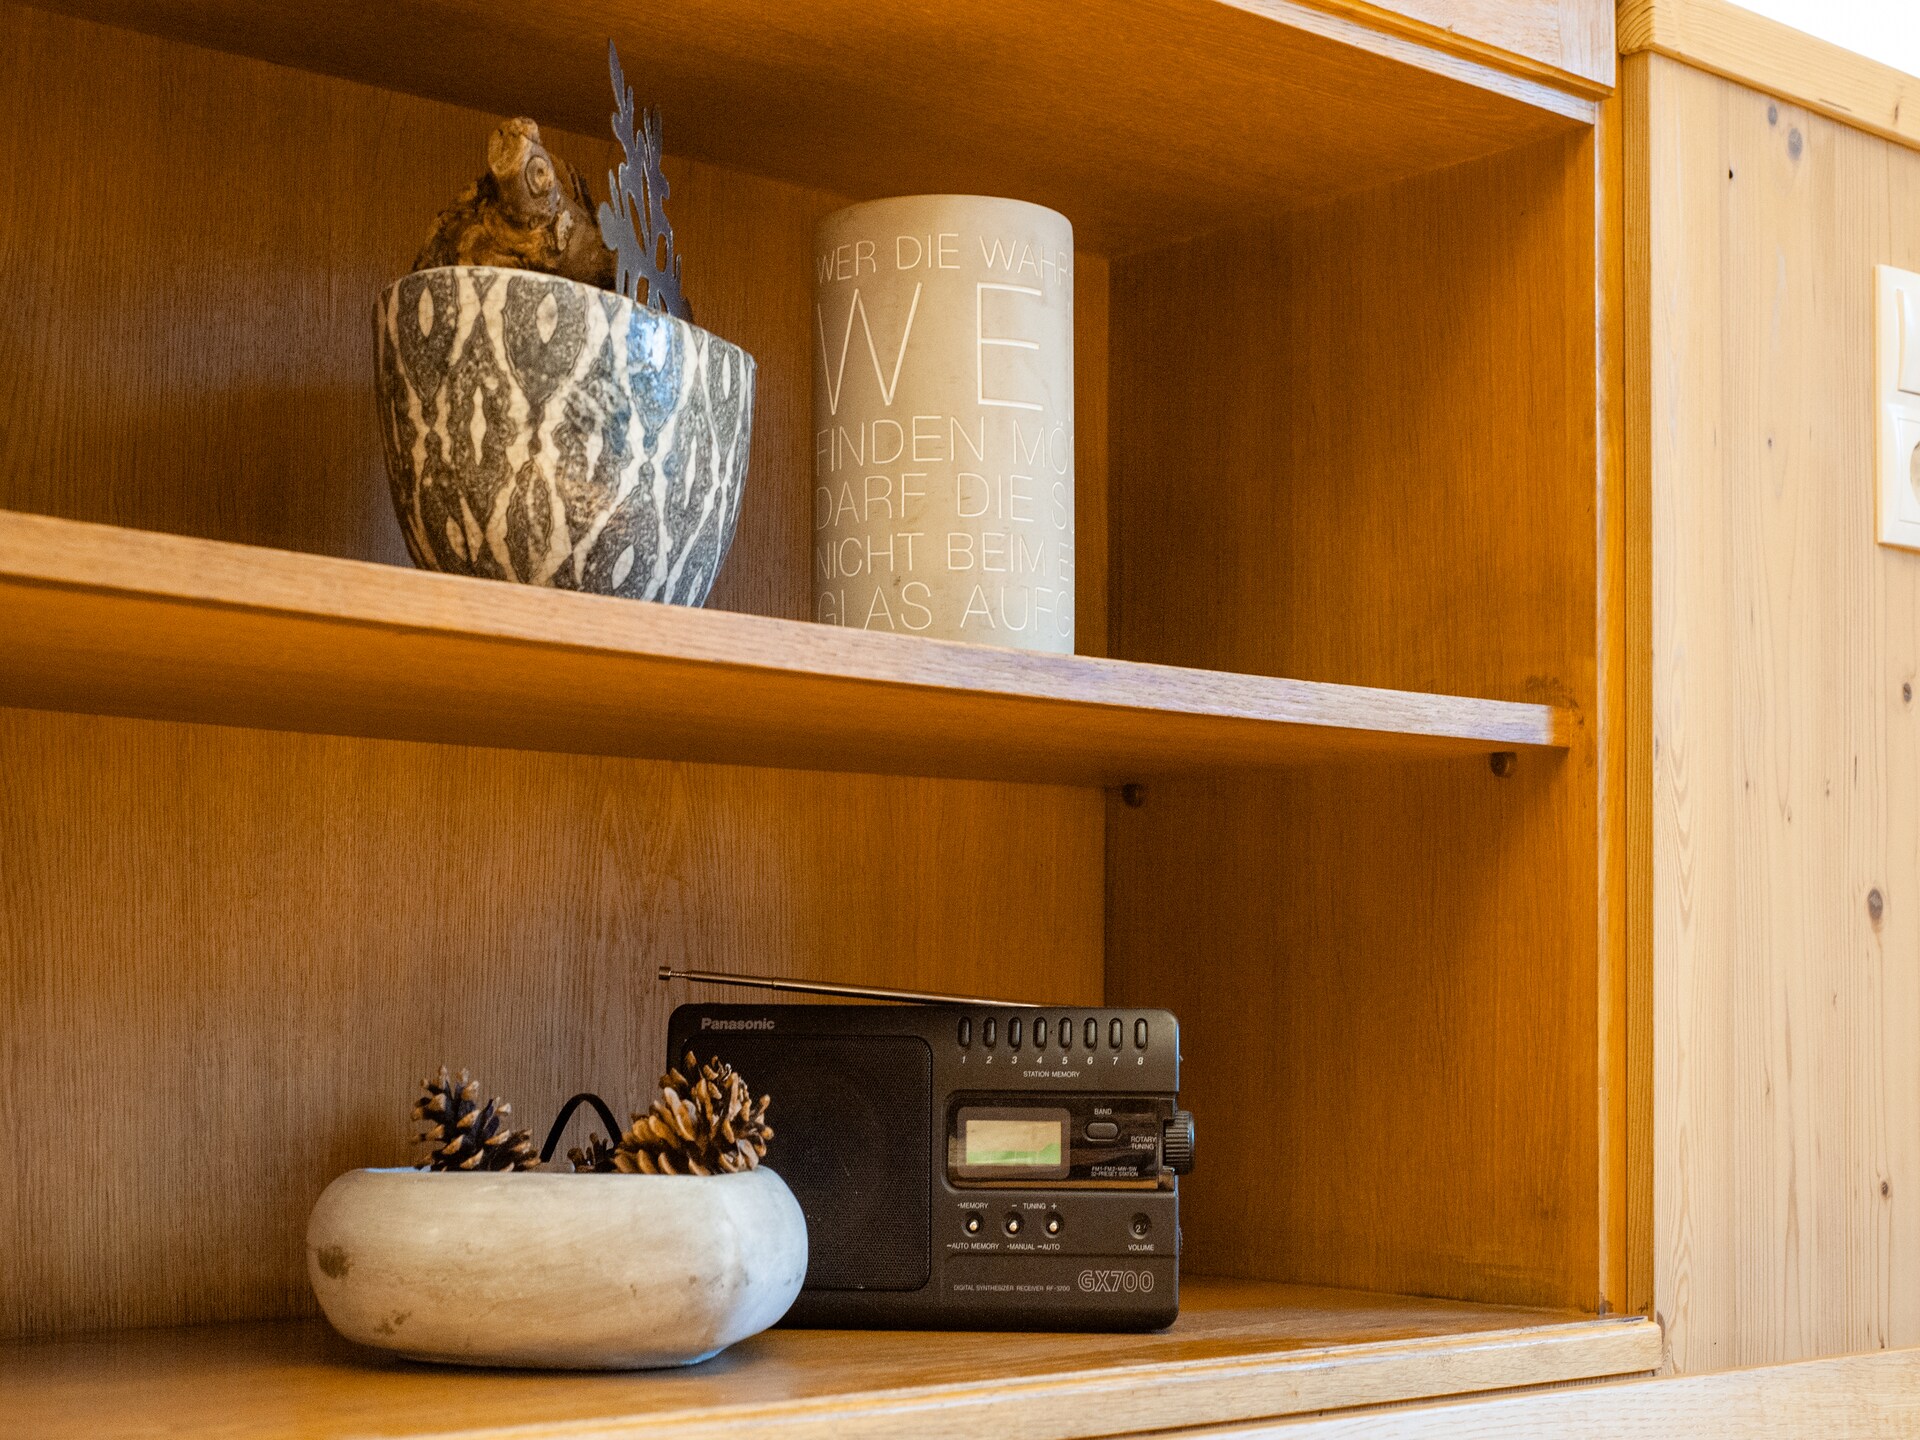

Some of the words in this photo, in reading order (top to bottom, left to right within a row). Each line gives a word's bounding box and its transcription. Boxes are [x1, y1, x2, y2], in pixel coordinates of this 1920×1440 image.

[816, 240, 877, 284] WER
[896, 233, 961, 271] DIE
[816, 415, 985, 477] FINDEN
[816, 473, 928, 530] DARF
[956, 472, 1034, 522] DIE
[816, 532, 925, 582] NICHT
[947, 532, 1046, 577] BEIM
[701, 1017, 775, 1030] Panasonic
[961, 1056, 966, 1064] 1
[985, 1056, 992, 1064] 2
[1011, 1056, 1018, 1064] 3
[1036, 1056, 1043, 1064] 4
[1062, 1056, 1068, 1065] 5
[1087, 1056, 1094, 1065] 6
[1112, 1056, 1119, 1065] 7
[1137, 1056, 1144, 1065] 8
[1023, 1070, 1050, 1078] STATION
[1051, 1070, 1080, 1078] MEMORY
[970, 1242, 1000, 1250] MEMORY
[1077, 1269, 1155, 1293] GX700
